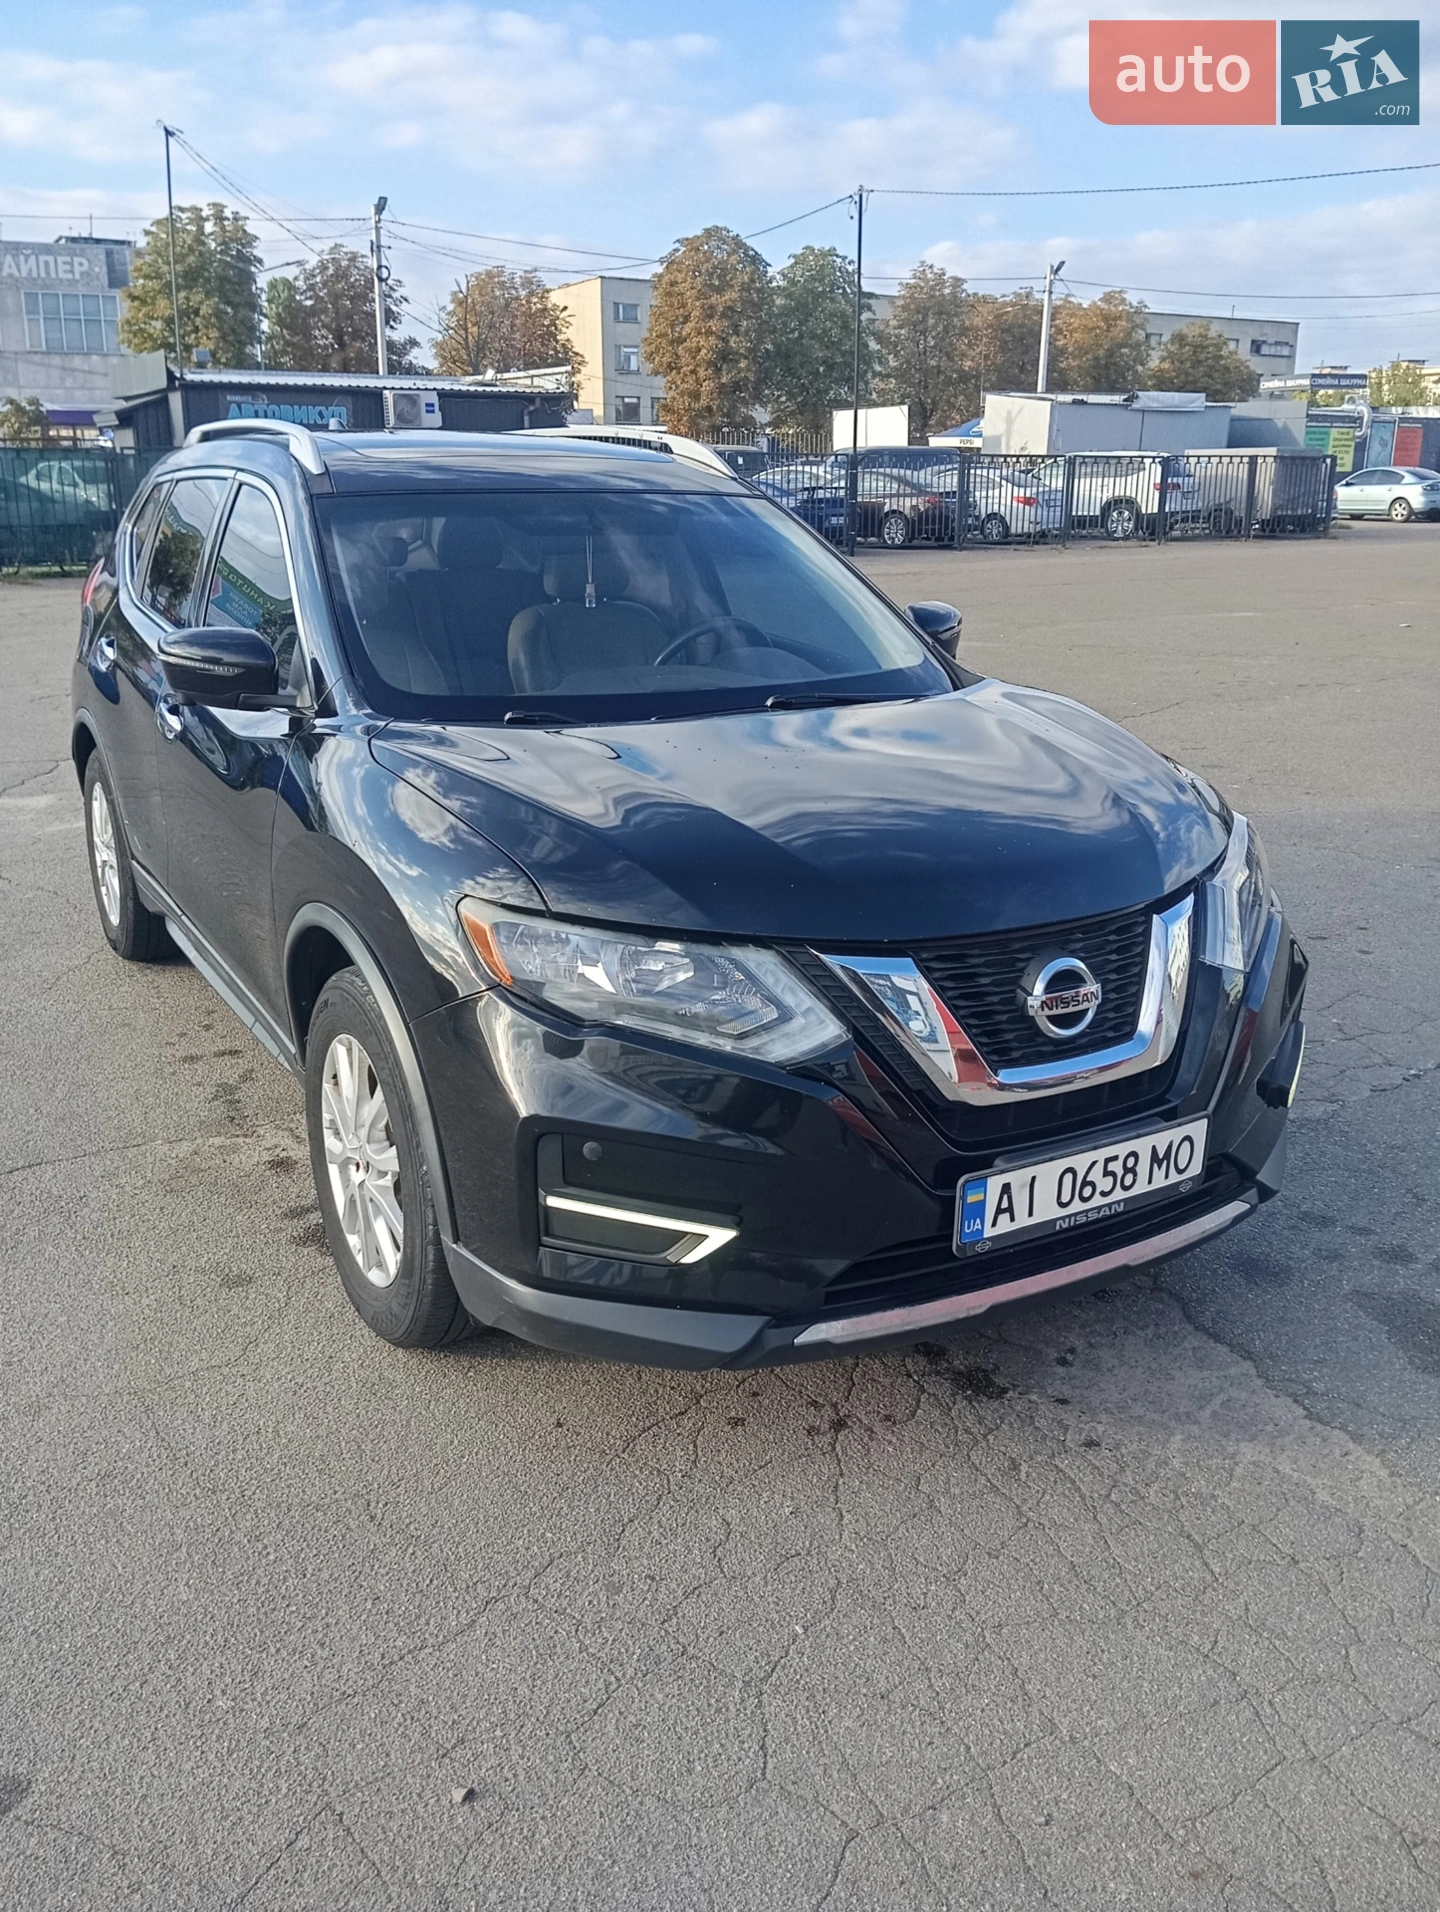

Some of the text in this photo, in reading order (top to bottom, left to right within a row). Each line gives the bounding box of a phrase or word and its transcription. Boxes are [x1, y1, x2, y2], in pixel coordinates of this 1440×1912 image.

[227, 403, 347, 425] АВТОВИКУП
[1041, 989, 1098, 1012] NISSAN
[991, 1134, 1195, 1228] AI 0658 MO
[964, 1217, 982, 1233] UA
[1055, 1201, 1124, 1231] NISSAN
